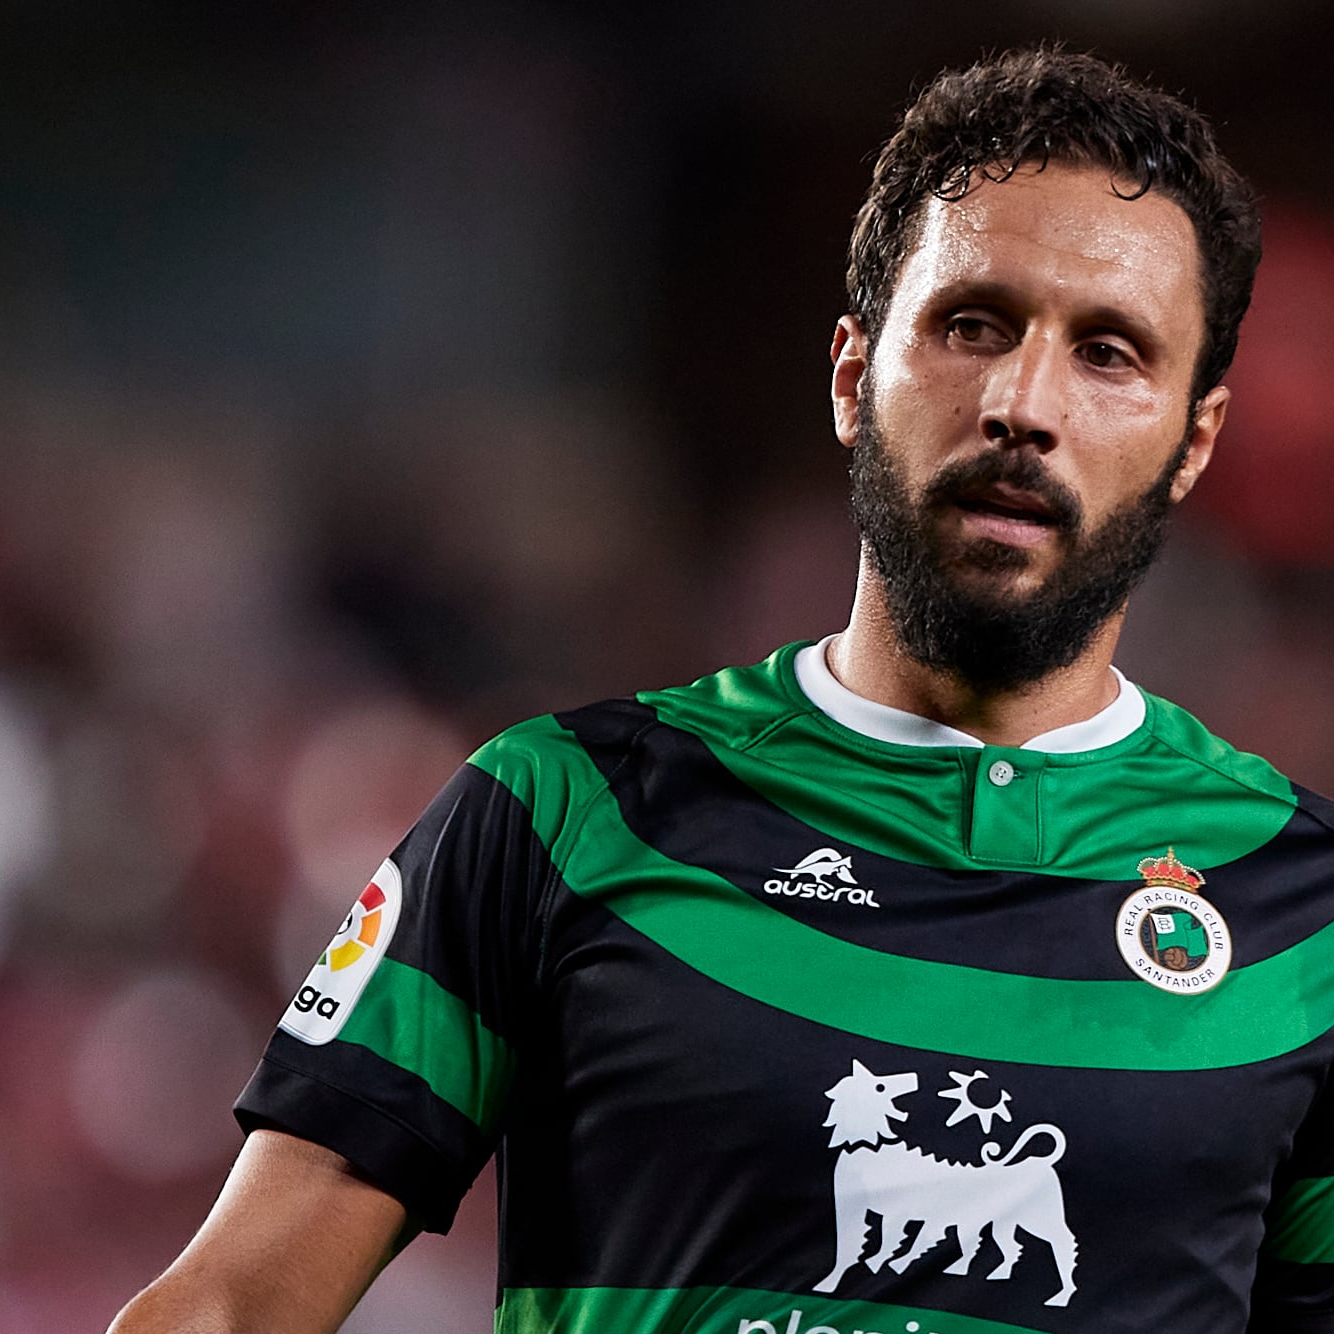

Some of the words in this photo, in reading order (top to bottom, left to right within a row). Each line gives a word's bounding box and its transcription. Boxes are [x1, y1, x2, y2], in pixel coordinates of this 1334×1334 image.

[763, 879, 881, 908] austral
[1124, 905, 1143, 936] REAL
[1143, 892, 1199, 911] RACING
[1204, 912, 1223, 950] CLUB
[1136, 958, 1215, 987] SANTANDER
